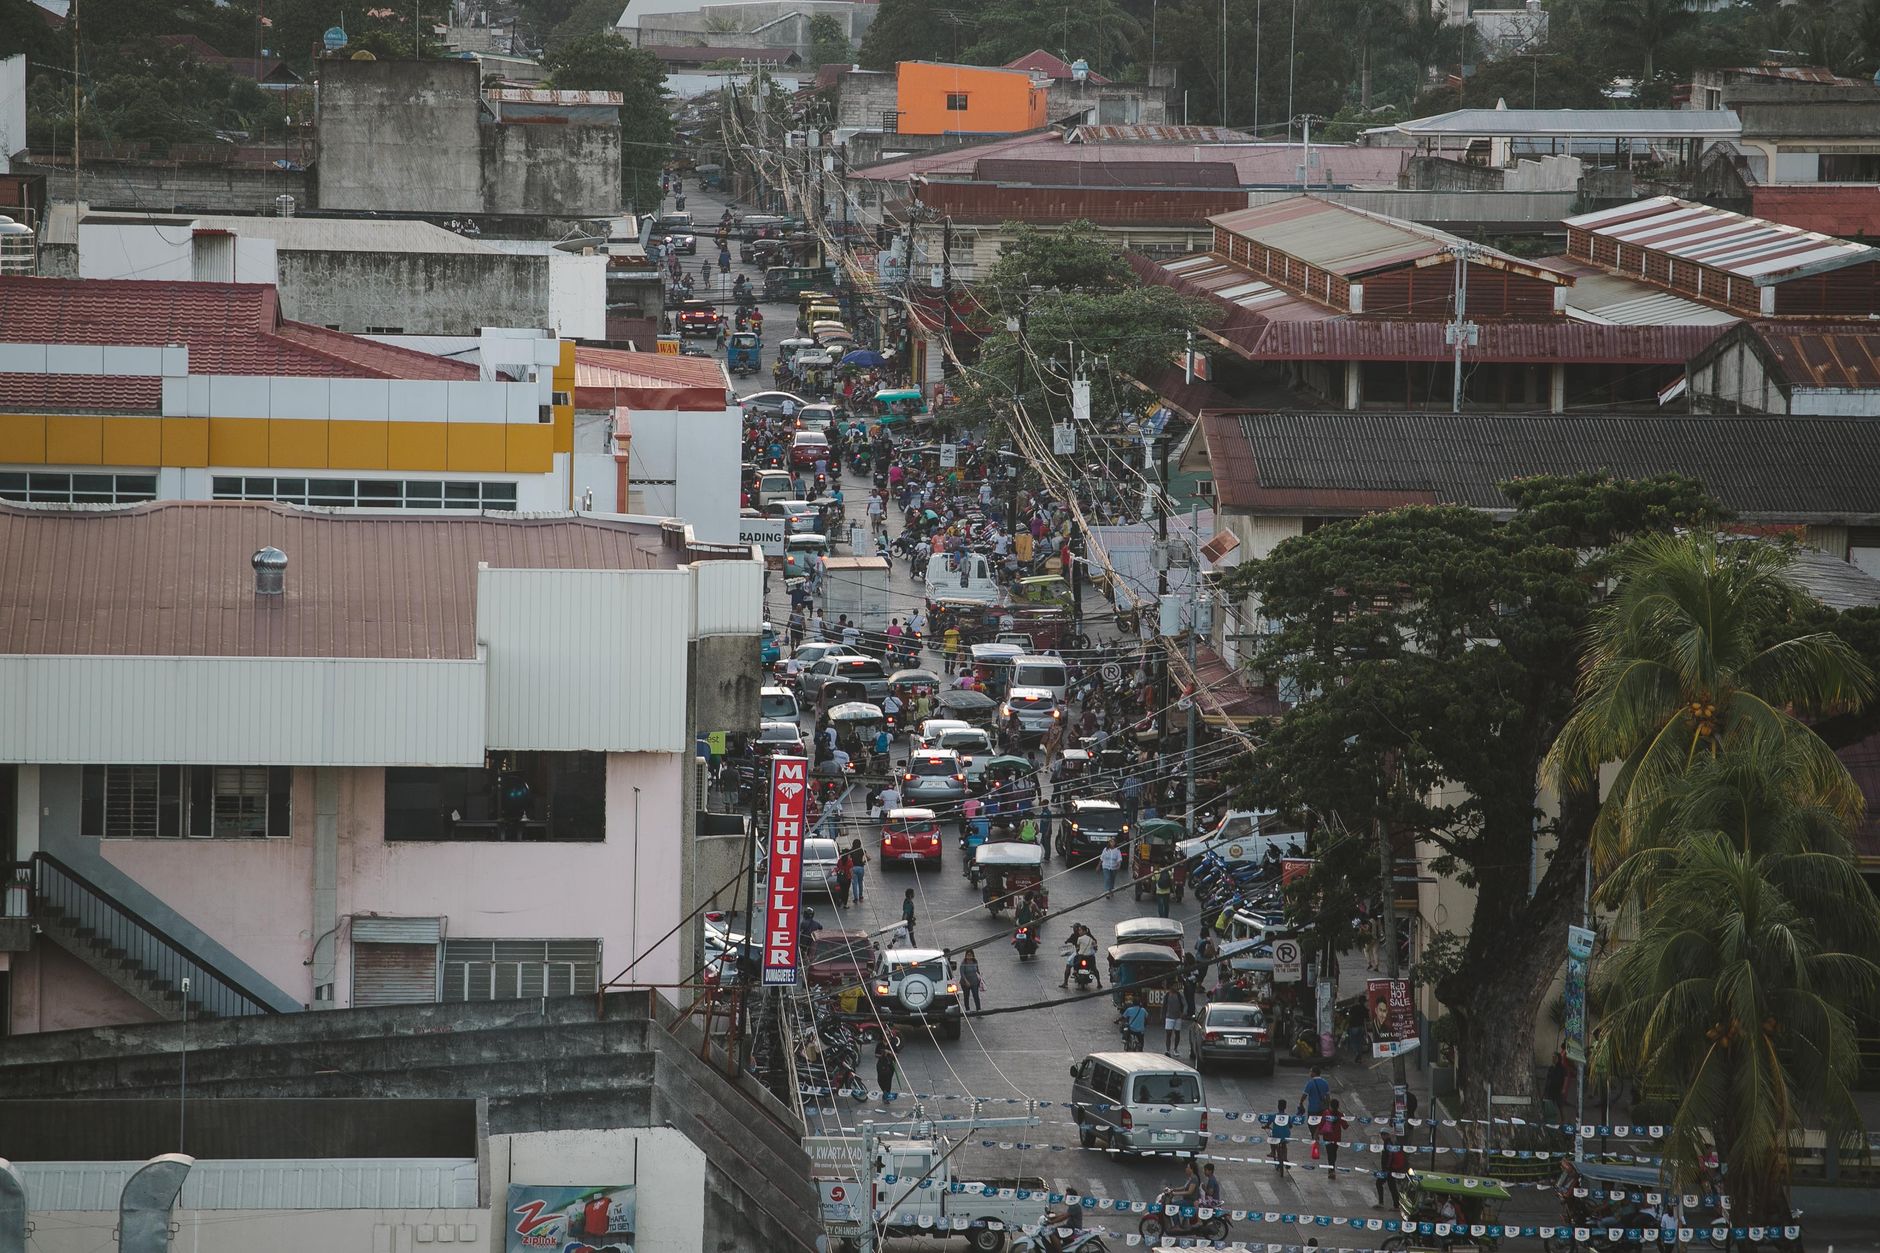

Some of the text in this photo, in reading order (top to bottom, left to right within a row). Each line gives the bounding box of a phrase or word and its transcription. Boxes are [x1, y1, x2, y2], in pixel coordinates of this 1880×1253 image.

[739, 532, 782, 542] RADING
[1390, 990, 1406, 999] HOT
[1390, 998, 1411, 1007] SALE
[816, 1146, 846, 1160] KWARTA
[522, 1235, 557, 1246] Ziplink
